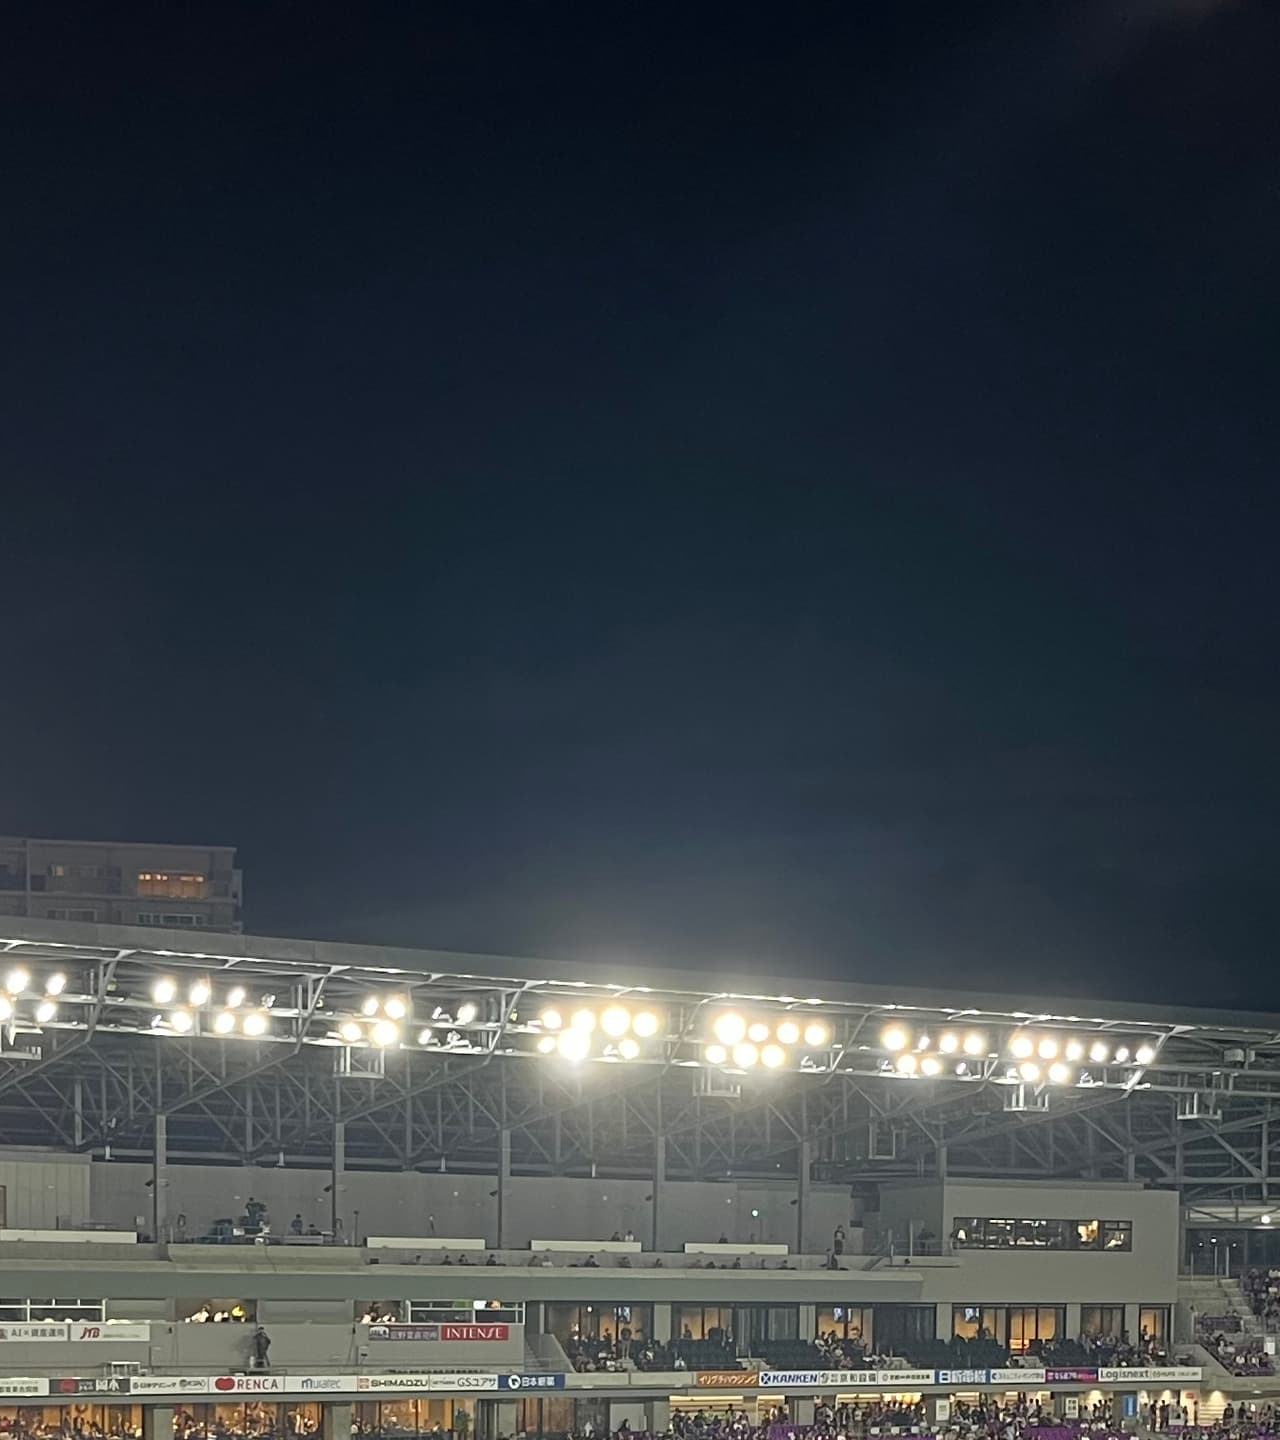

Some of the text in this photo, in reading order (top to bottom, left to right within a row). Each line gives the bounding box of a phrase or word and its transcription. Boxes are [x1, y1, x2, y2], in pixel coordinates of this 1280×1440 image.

[80, 1327, 100, 1340] JTB
[446, 1327, 503, 1339] INTENSE
[772, 1373, 818, 1384] KANKEN
[1100, 1369, 1149, 1380] Logisnext
[237, 1377, 279, 1390] RENCA
[371, 1379, 428, 1388] SHIMADZU
[457, 1377, 496, 1387] GSユアサ
